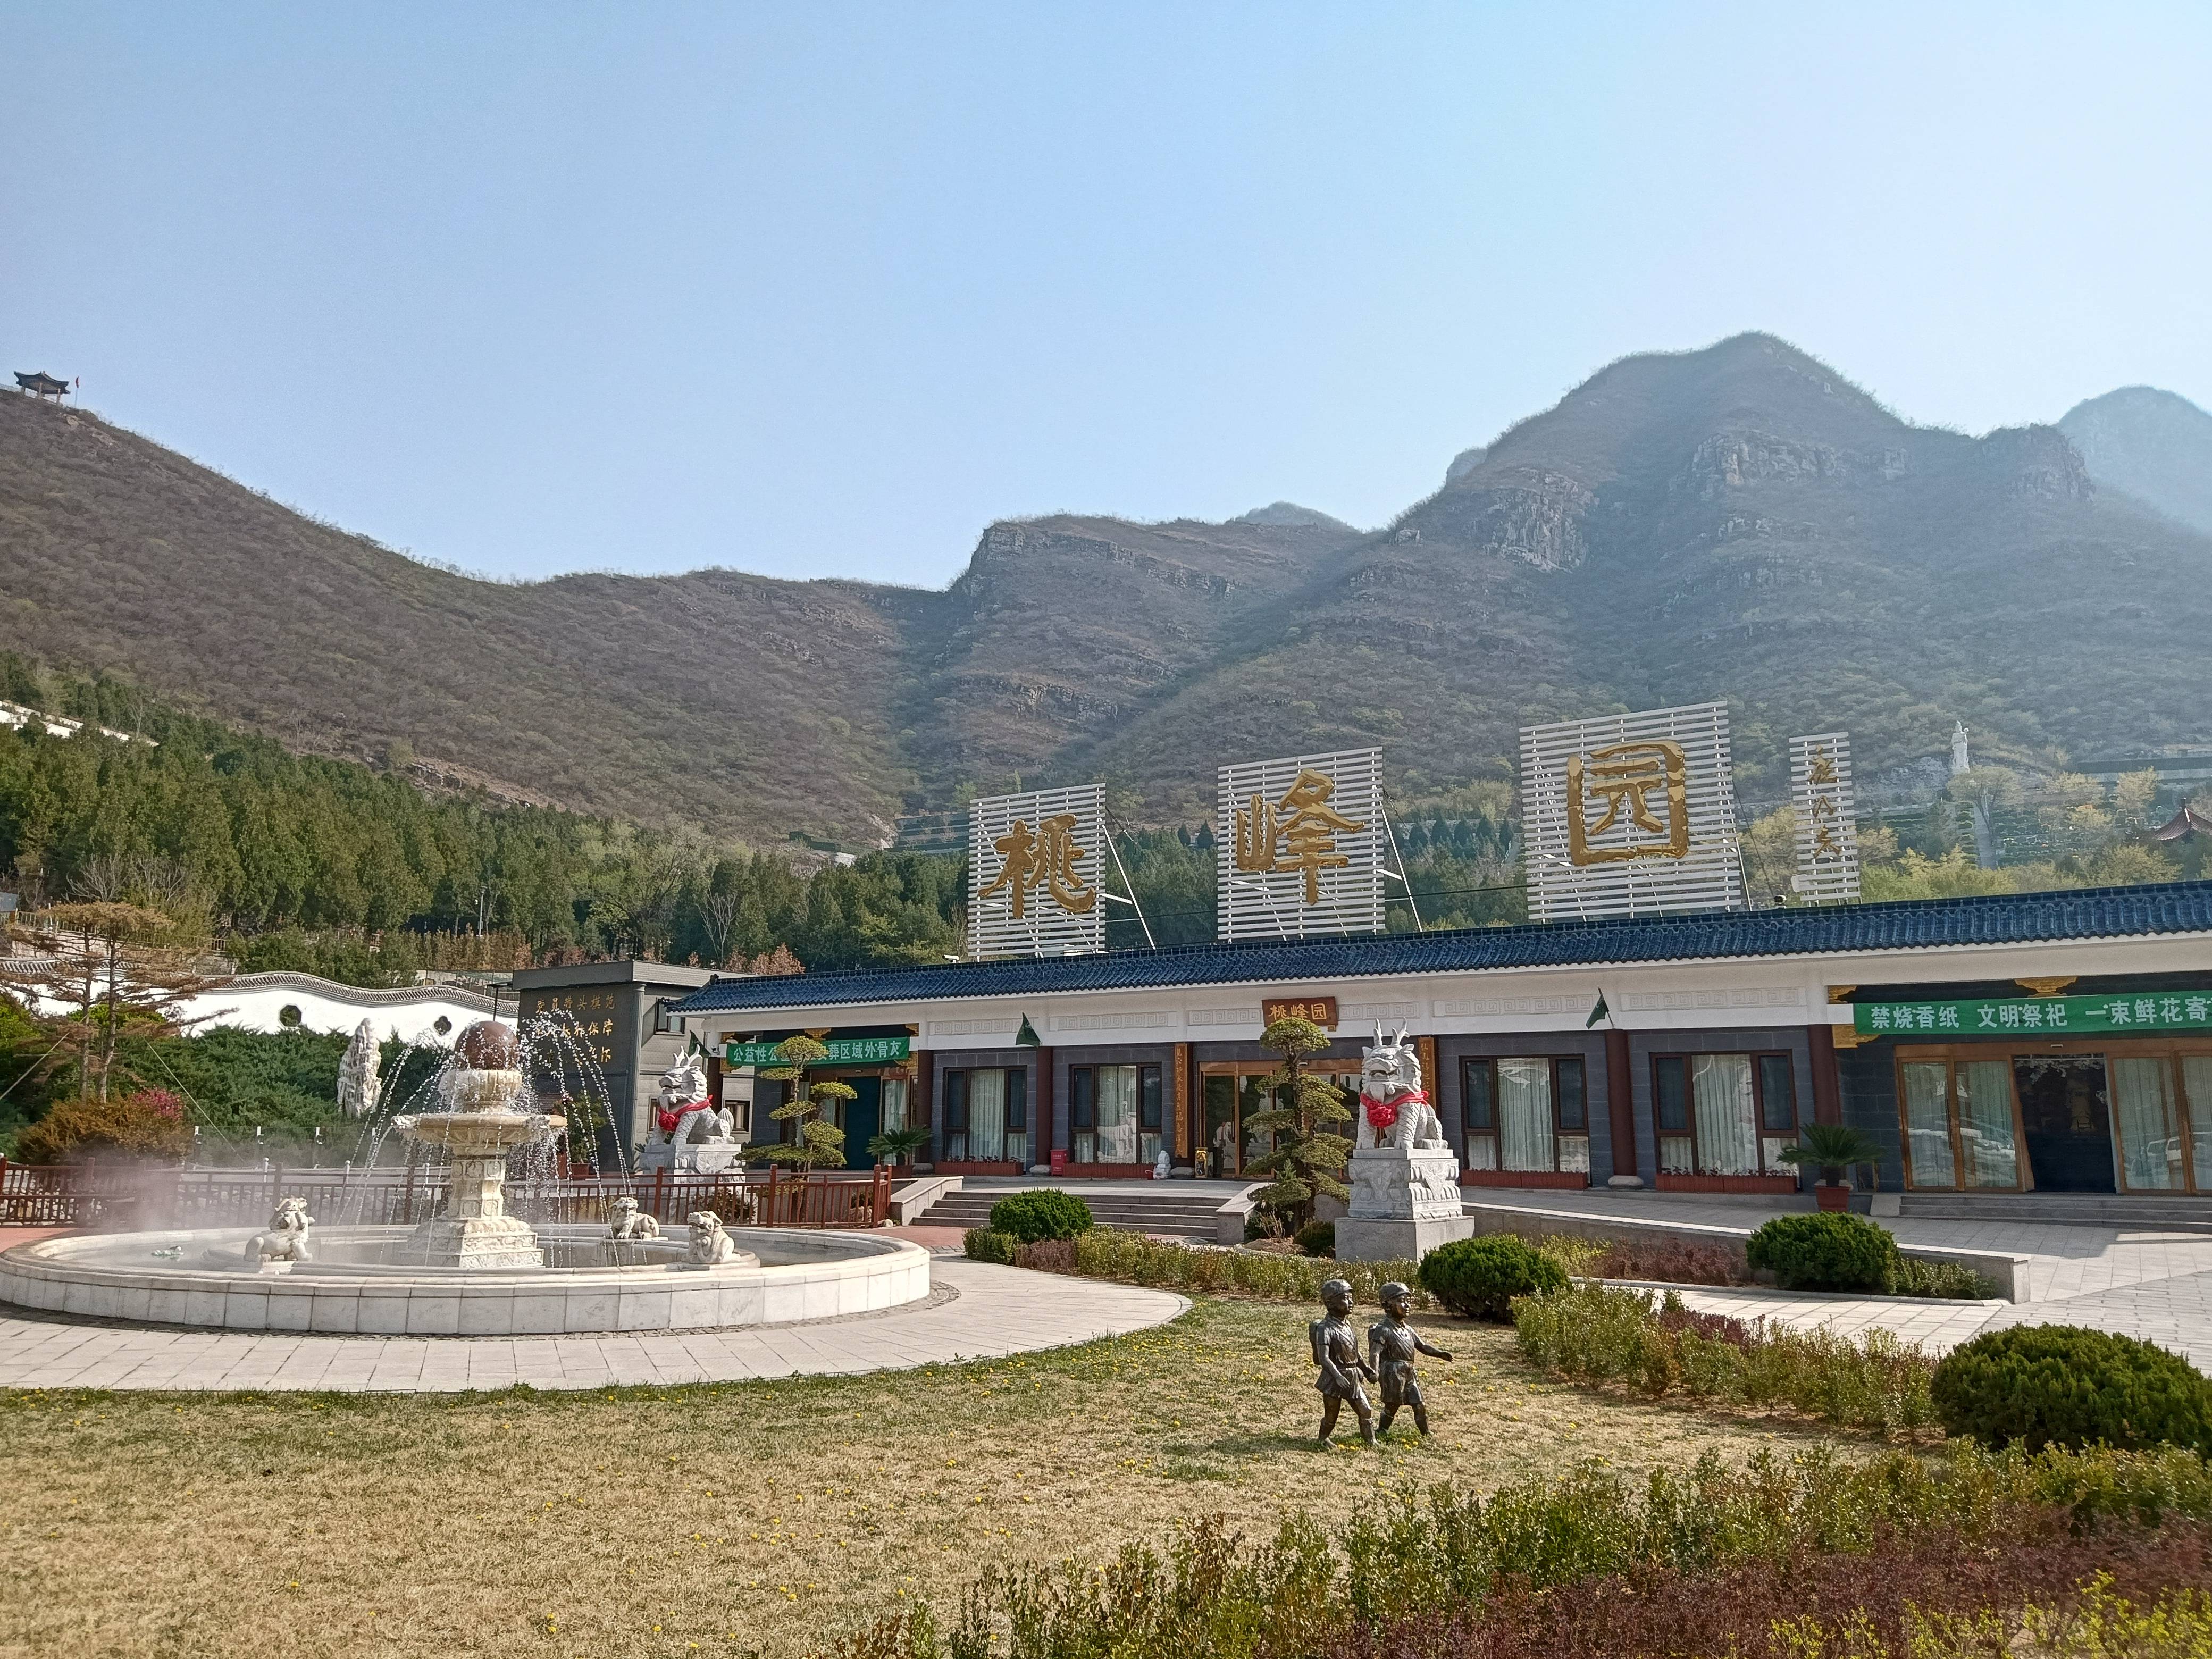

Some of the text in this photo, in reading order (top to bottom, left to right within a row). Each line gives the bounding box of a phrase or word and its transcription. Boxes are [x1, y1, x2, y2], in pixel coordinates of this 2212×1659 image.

[978, 740, 1689, 919] 桃峰园
[1268, 1003, 1327, 1021] 桃峰园
[1871, 995, 2212, 1029] 禁烧香纸 文明祭祀 一束鲜花寄
